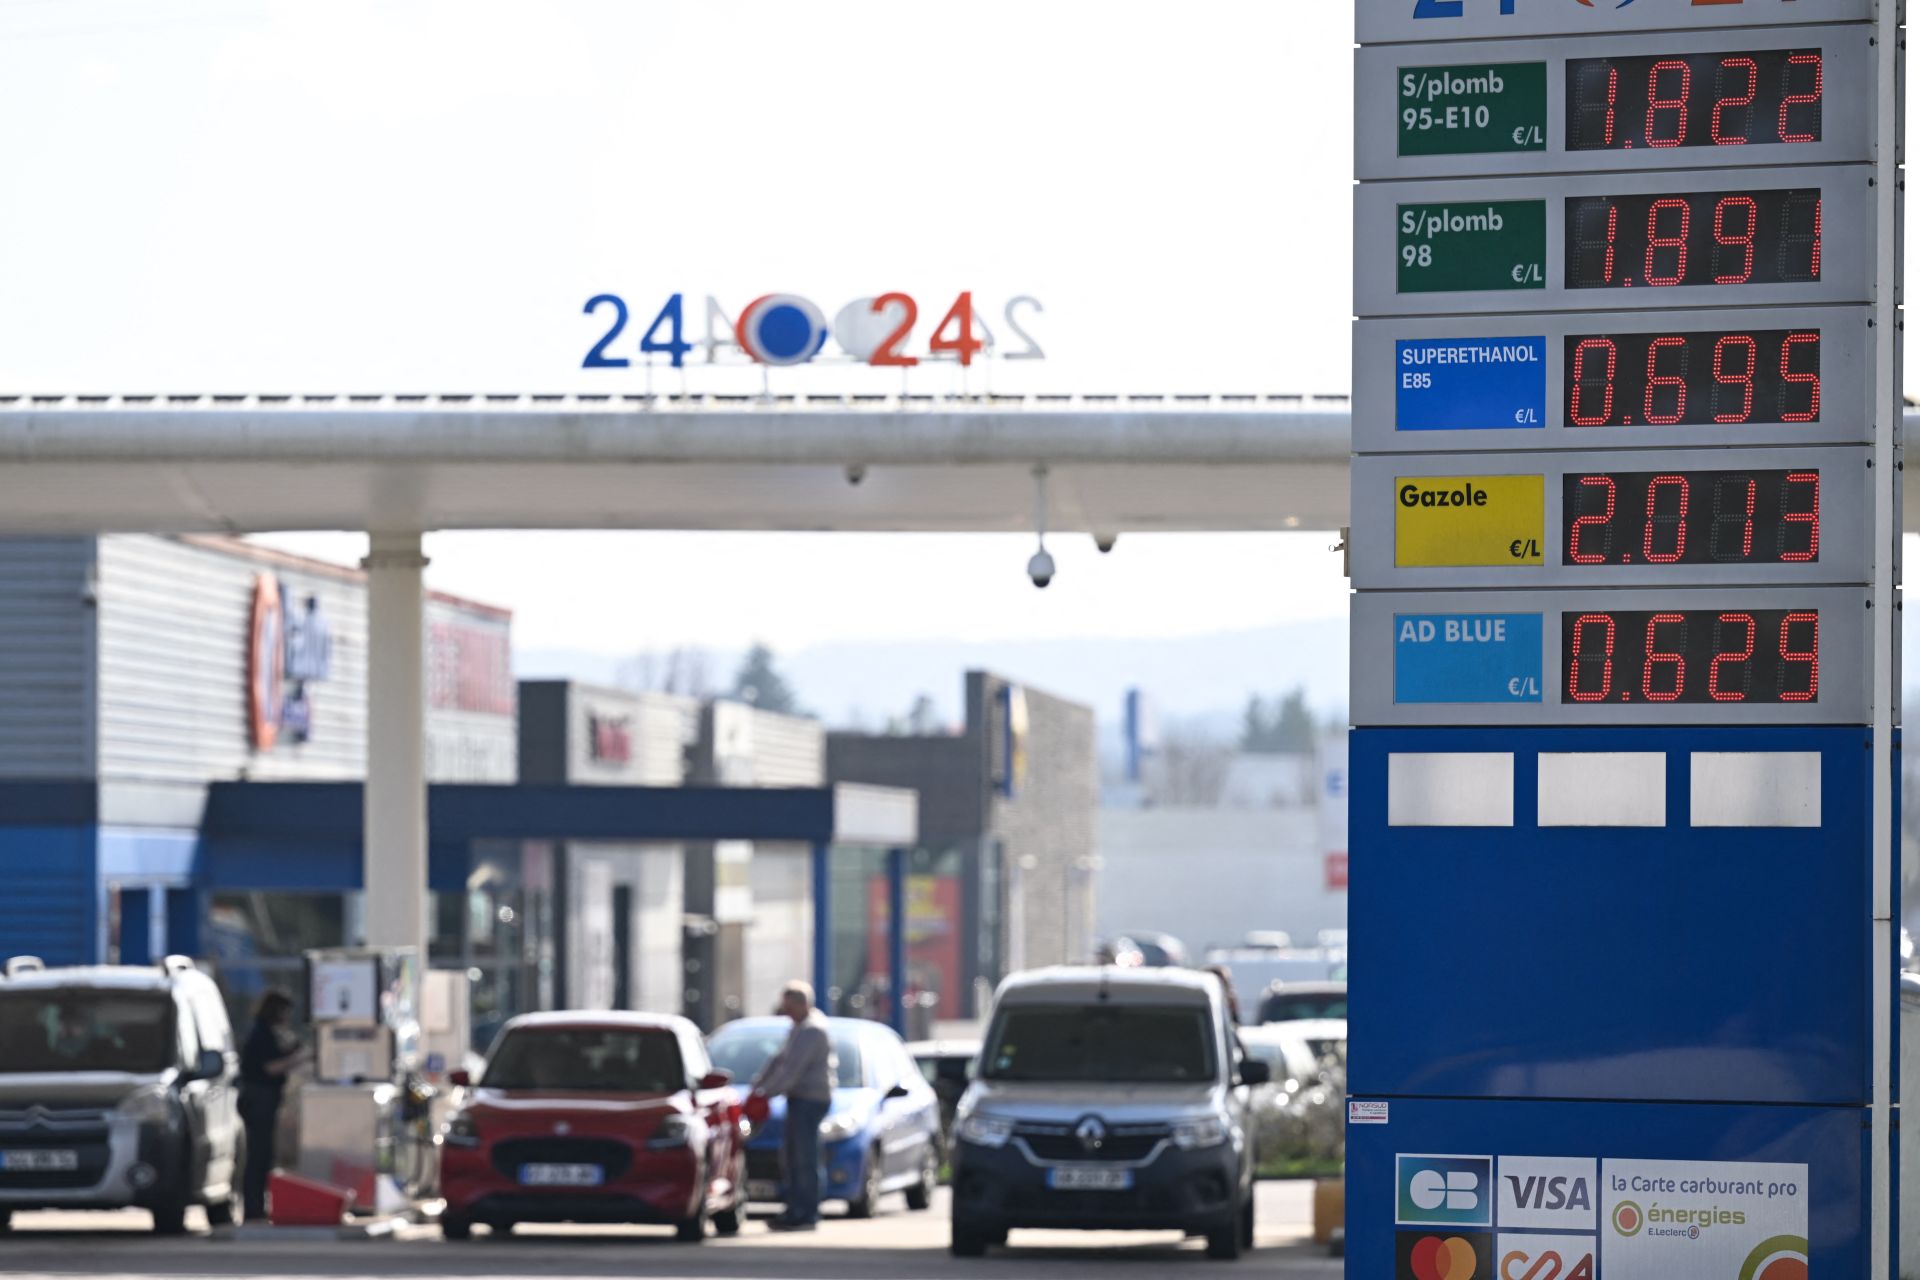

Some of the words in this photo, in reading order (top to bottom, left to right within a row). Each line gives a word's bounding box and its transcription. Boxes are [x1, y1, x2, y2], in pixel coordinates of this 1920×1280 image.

[1402, 69, 1504, 101] S/plomb
[1605, 55, 1823, 149] 1.822
[1402, 105, 1490, 131] 95-E10
[1512, 126, 1544, 146] €/L
[1401, 207, 1504, 239] S/plomb
[1604, 196, 1822, 287] 1.891
[1402, 244, 1432, 268] 98
[1511, 263, 1543, 284] €/L
[582, 294, 692, 367] 24
[869, 291, 982, 366] 24
[1402, 345, 1538, 365] SUPERETHANOL
[1402, 373, 1431, 389] E85
[1570, 333, 1821, 426] 0.695
[1515, 408, 1537, 424] €/L
[1400, 483, 1487, 508] Gazole
[1569, 473, 1820, 564] 2.013
[1509, 539, 1540, 559] €/L
[1400, 620, 1435, 643] AD
[1445, 619, 1506, 642] BLUE
[1568, 613, 1819, 702] 0.629
[1508, 677, 1539, 697] €/L
[1504, 1175, 1591, 1211] VISA
[1612, 1175, 1627, 1191] la
[1631, 1176, 1675, 1193] Carte
[1680, 1177, 1764, 1195] carburant
[1768, 1182, 1797, 1198] pro
[1648, 1202, 1746, 1228] énergies
[1648, 1227, 1687, 1237] E.Leclerc
